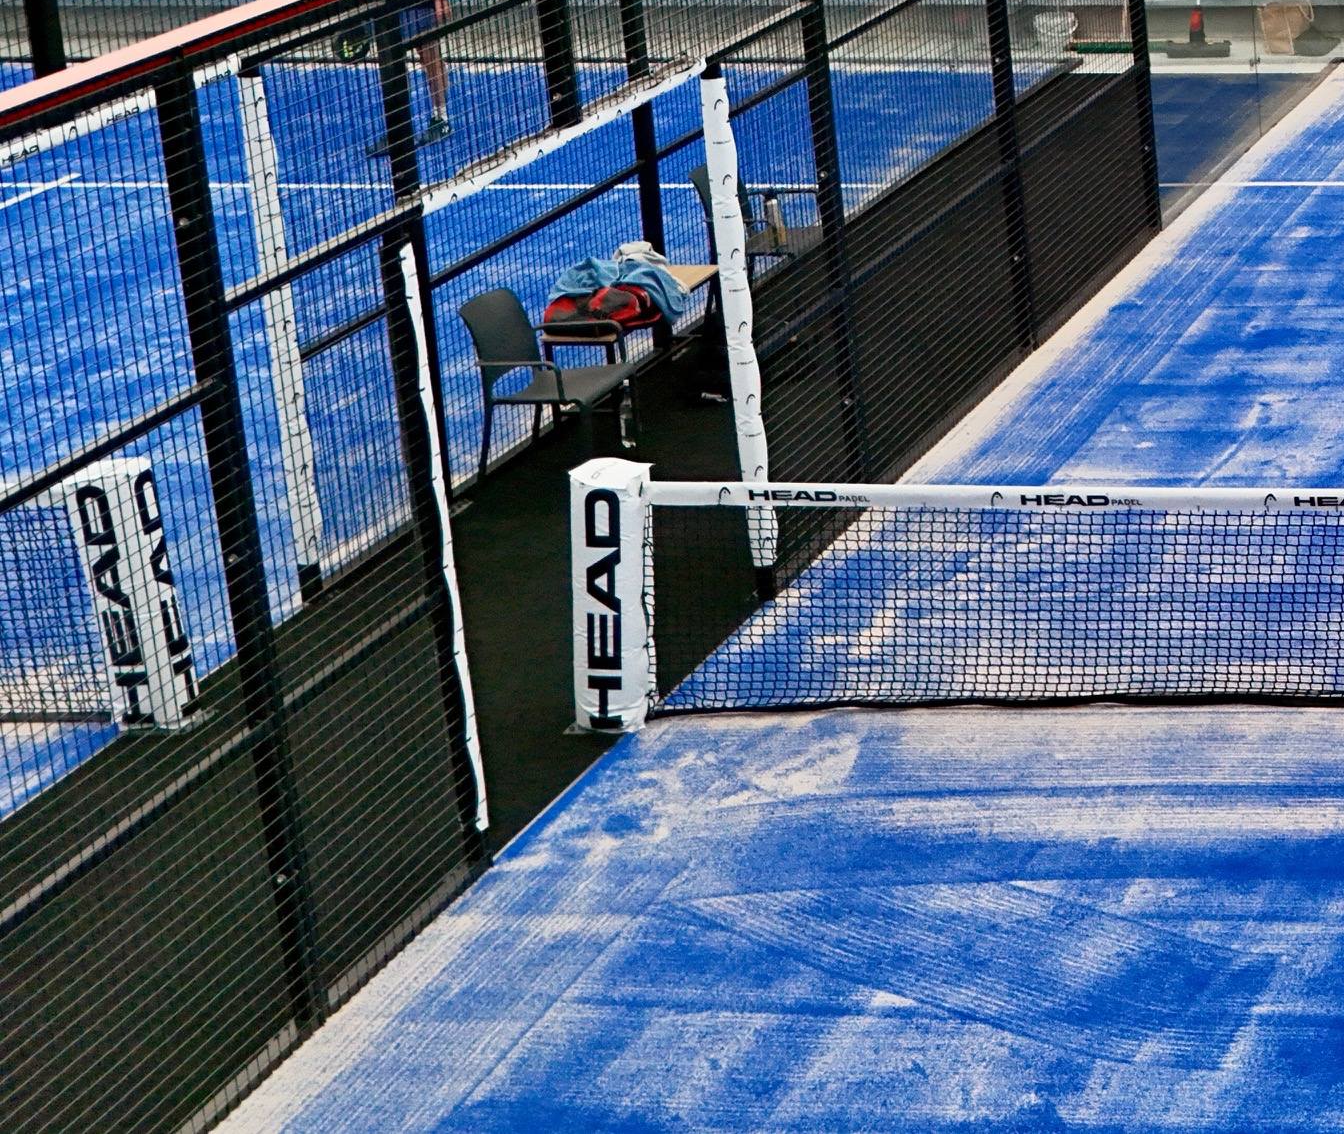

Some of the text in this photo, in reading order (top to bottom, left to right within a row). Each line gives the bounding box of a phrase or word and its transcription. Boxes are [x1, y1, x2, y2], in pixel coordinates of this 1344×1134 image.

[749, 490, 837, 502] HEAD
[1021, 495, 1109, 506] HEAD
[76, 485, 155, 724] HEAD
[584, 488, 623, 729] HEAD
